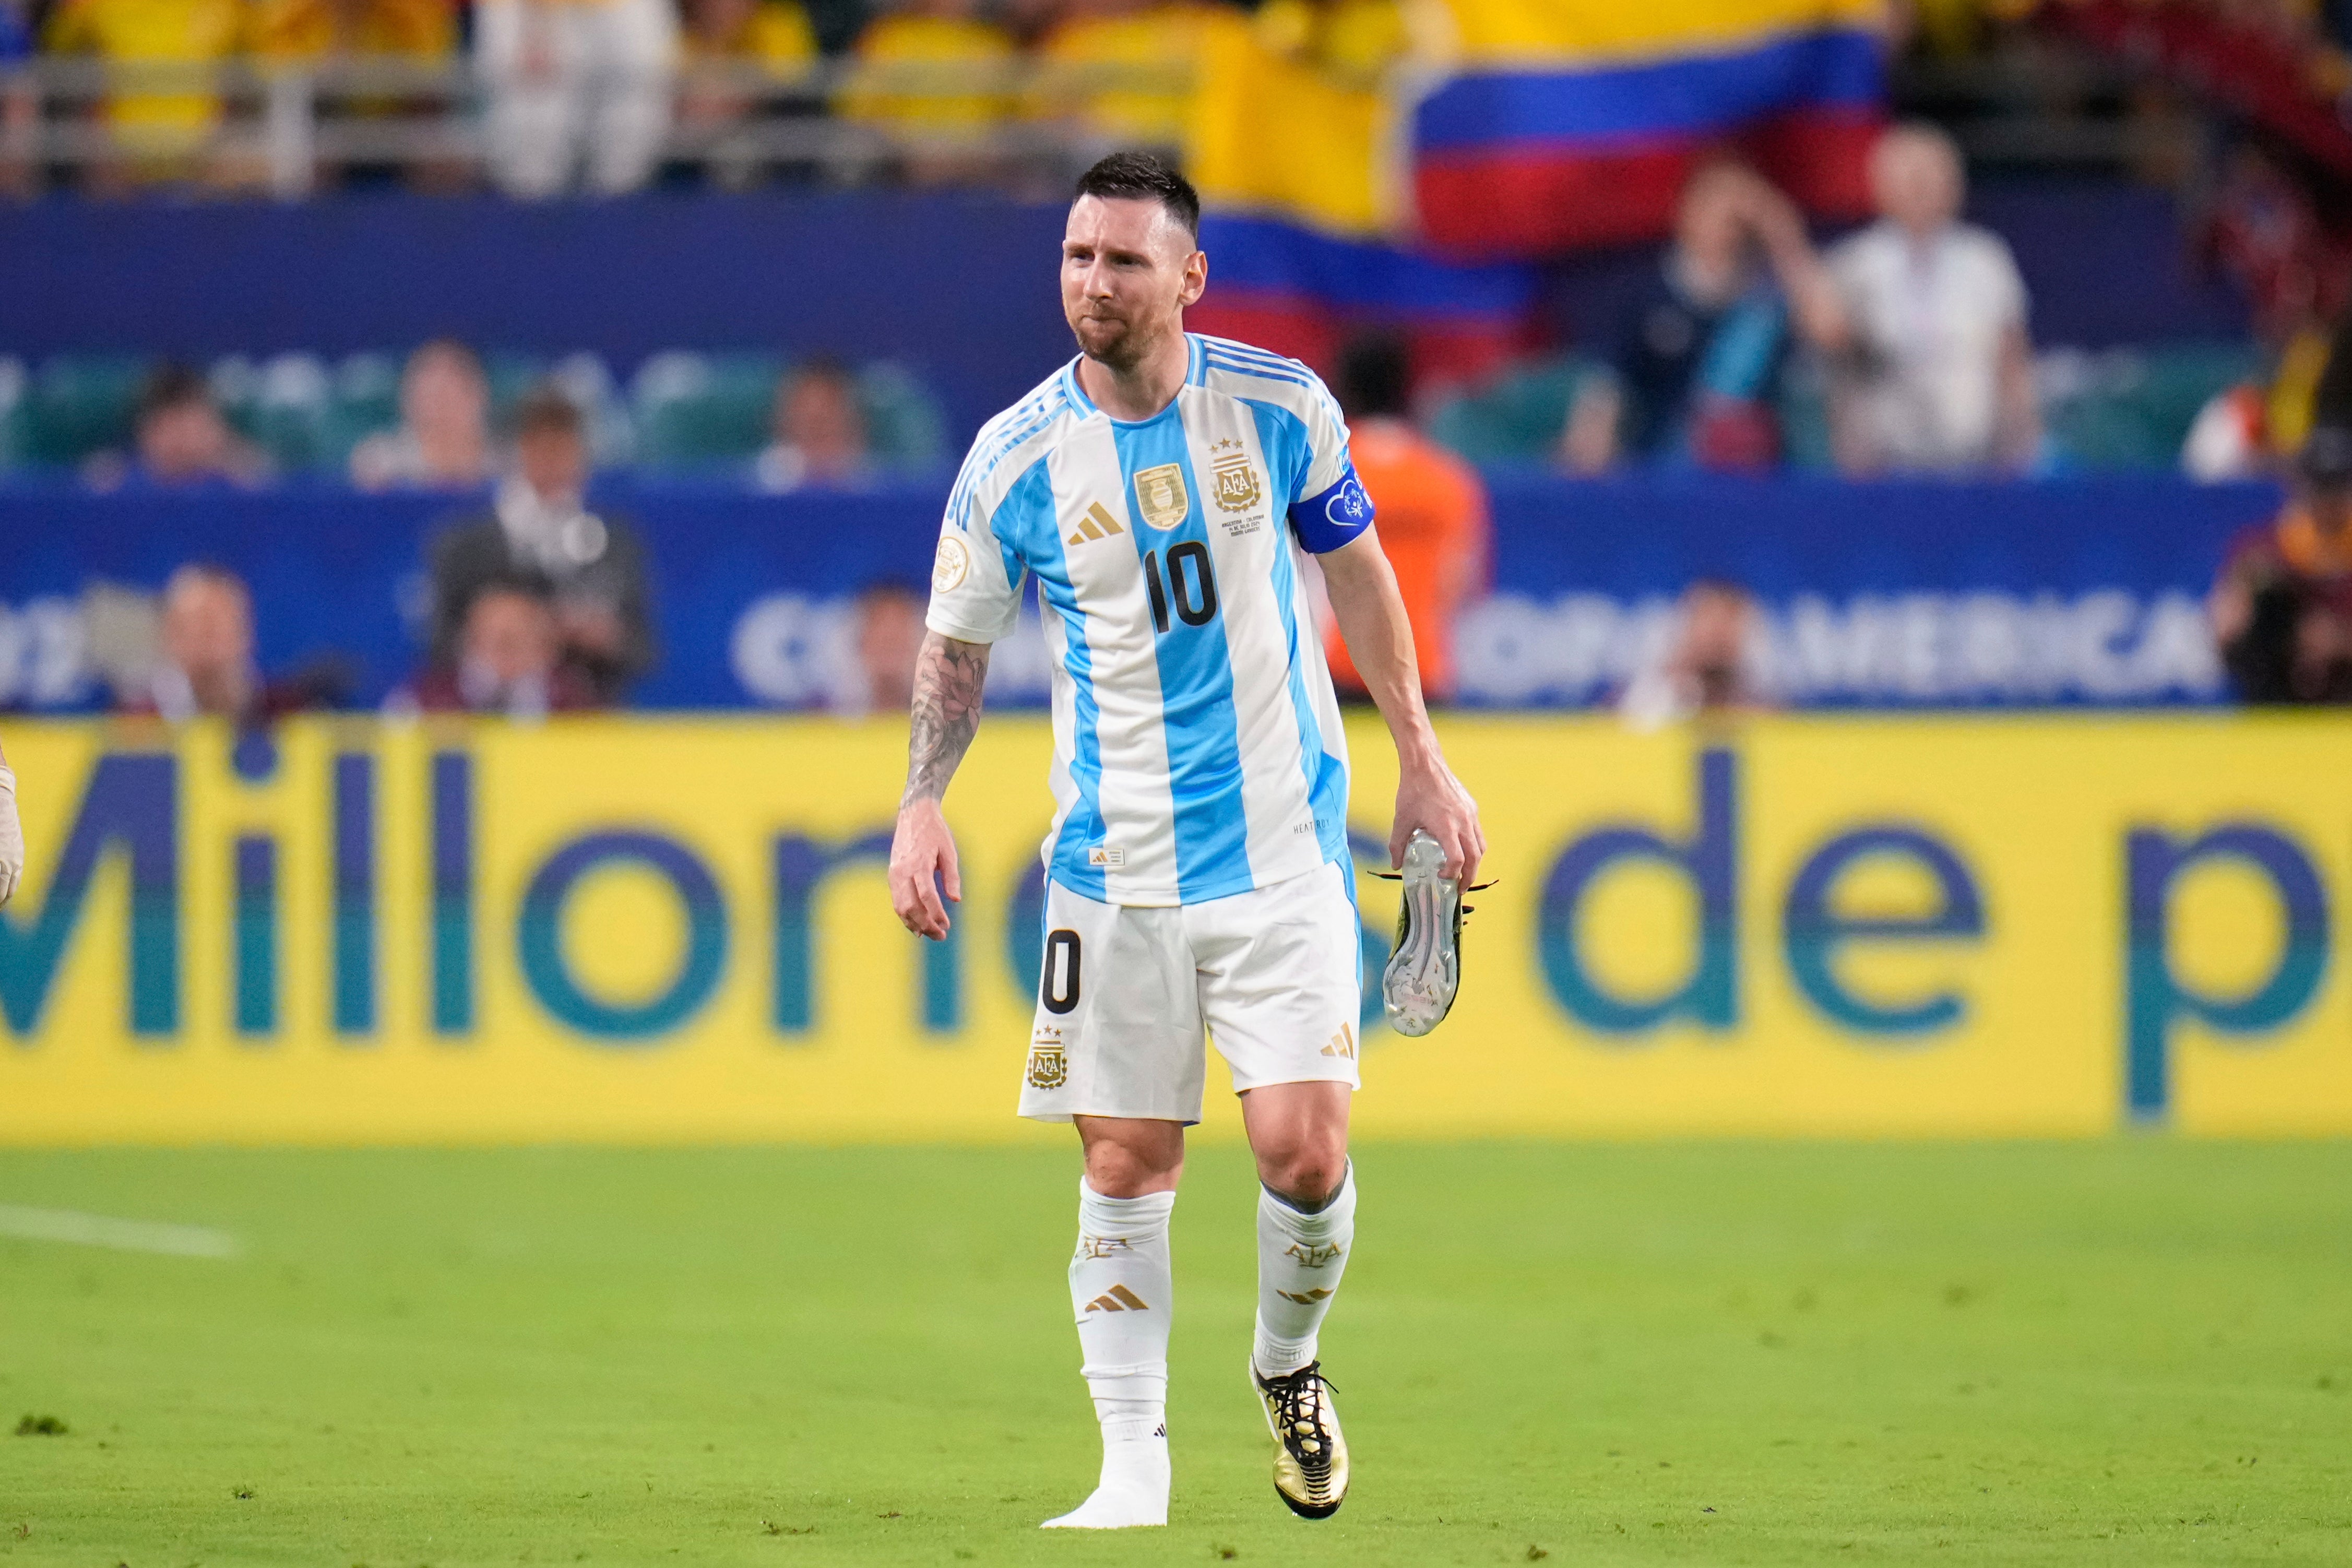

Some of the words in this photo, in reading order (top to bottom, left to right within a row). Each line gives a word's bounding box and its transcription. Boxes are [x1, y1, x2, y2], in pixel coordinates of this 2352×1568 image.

[1222, 469, 1251, 496] AFA
[1145, 541, 1217, 634] 10
[1535, 747, 1988, 1036] de
[2122, 823, 2333, 1117] p
[1034, 1053, 1059, 1076] AFA
